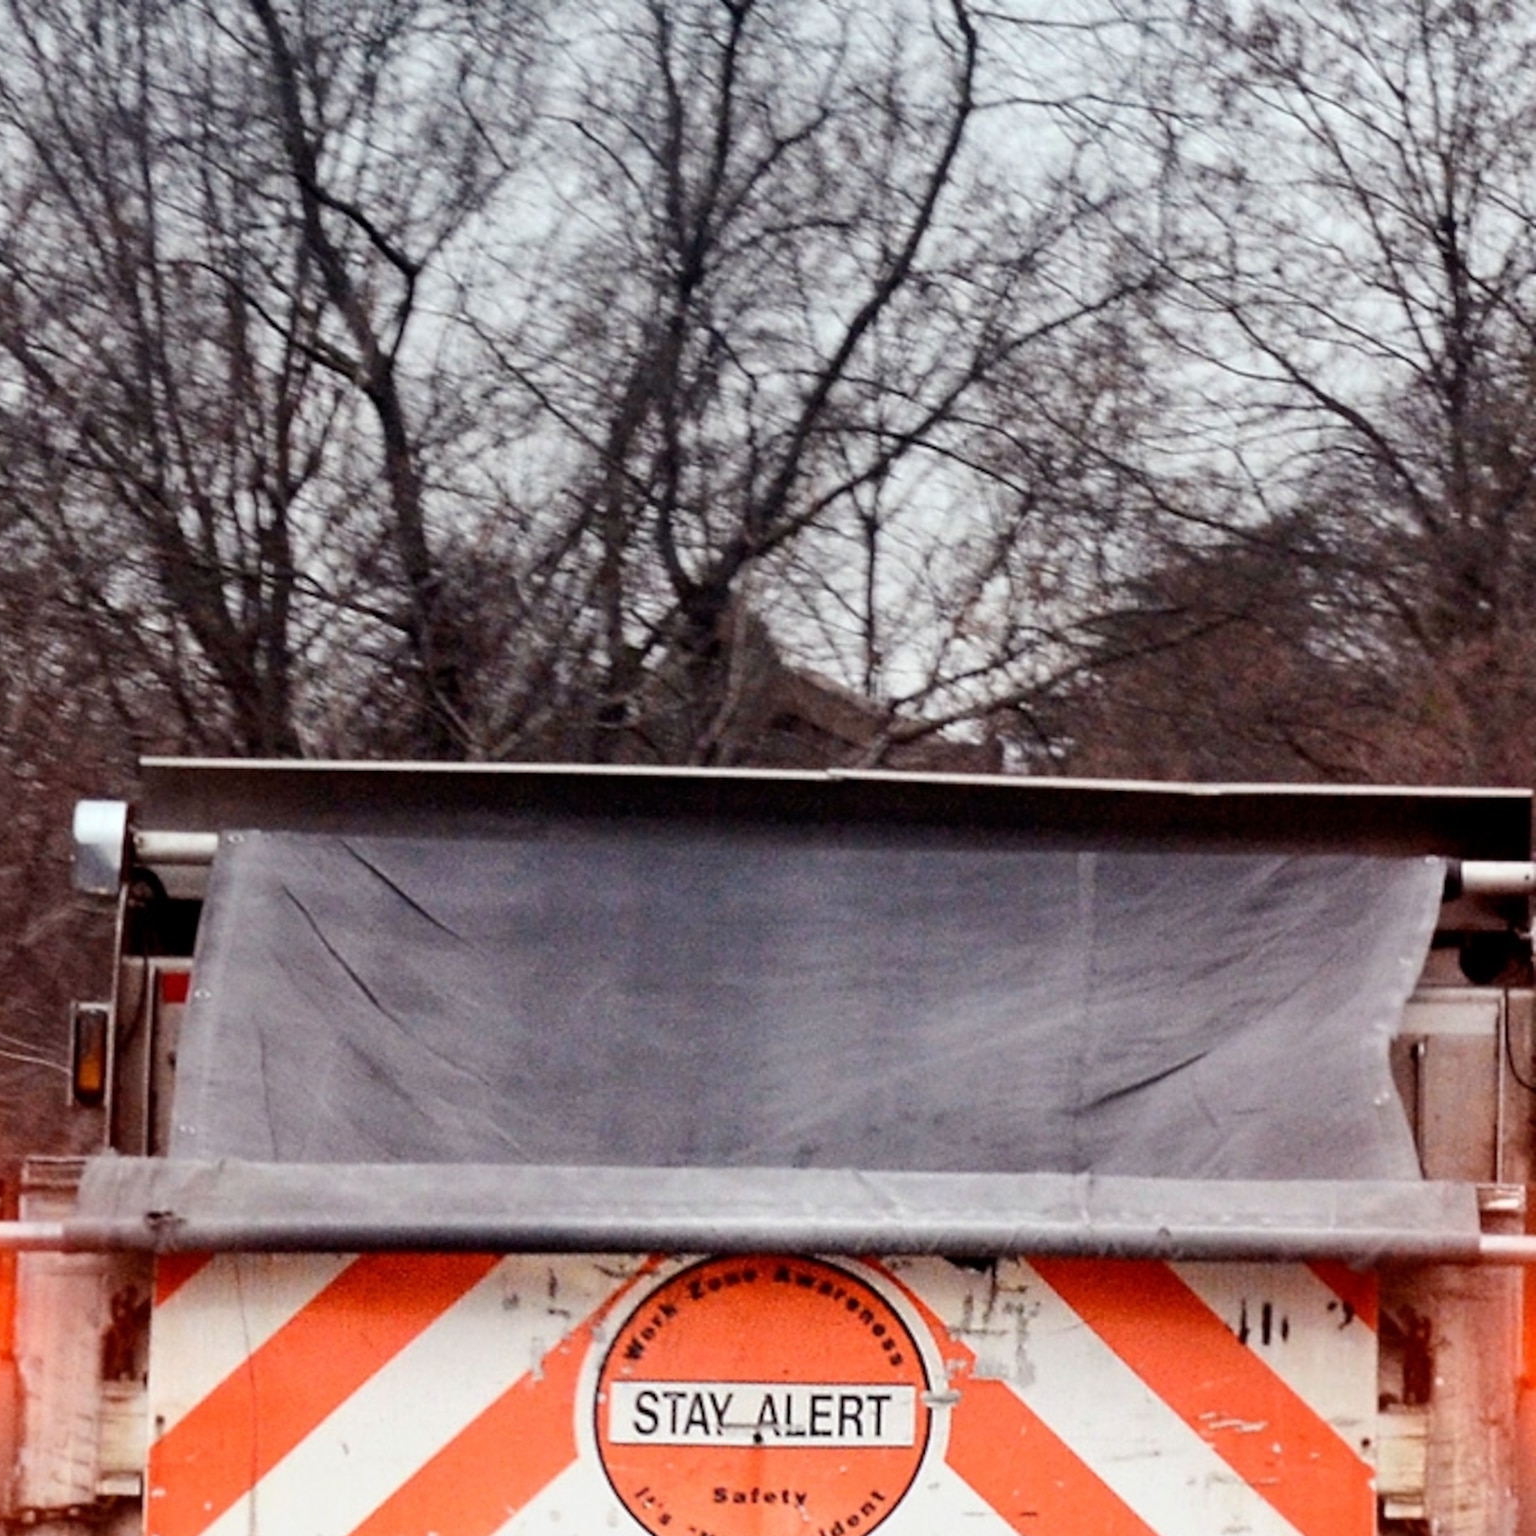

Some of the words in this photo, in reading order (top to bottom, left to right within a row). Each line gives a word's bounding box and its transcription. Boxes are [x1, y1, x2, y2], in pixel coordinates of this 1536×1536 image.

[623, 1303, 678, 1360] Work
[686, 1268, 758, 1301] Zone
[773, 1265, 903, 1367] Awareness
[633, 1390, 733, 1437] STAY
[756, 1392, 893, 1438] ALERT
[713, 1487, 807, 1508] Safety
